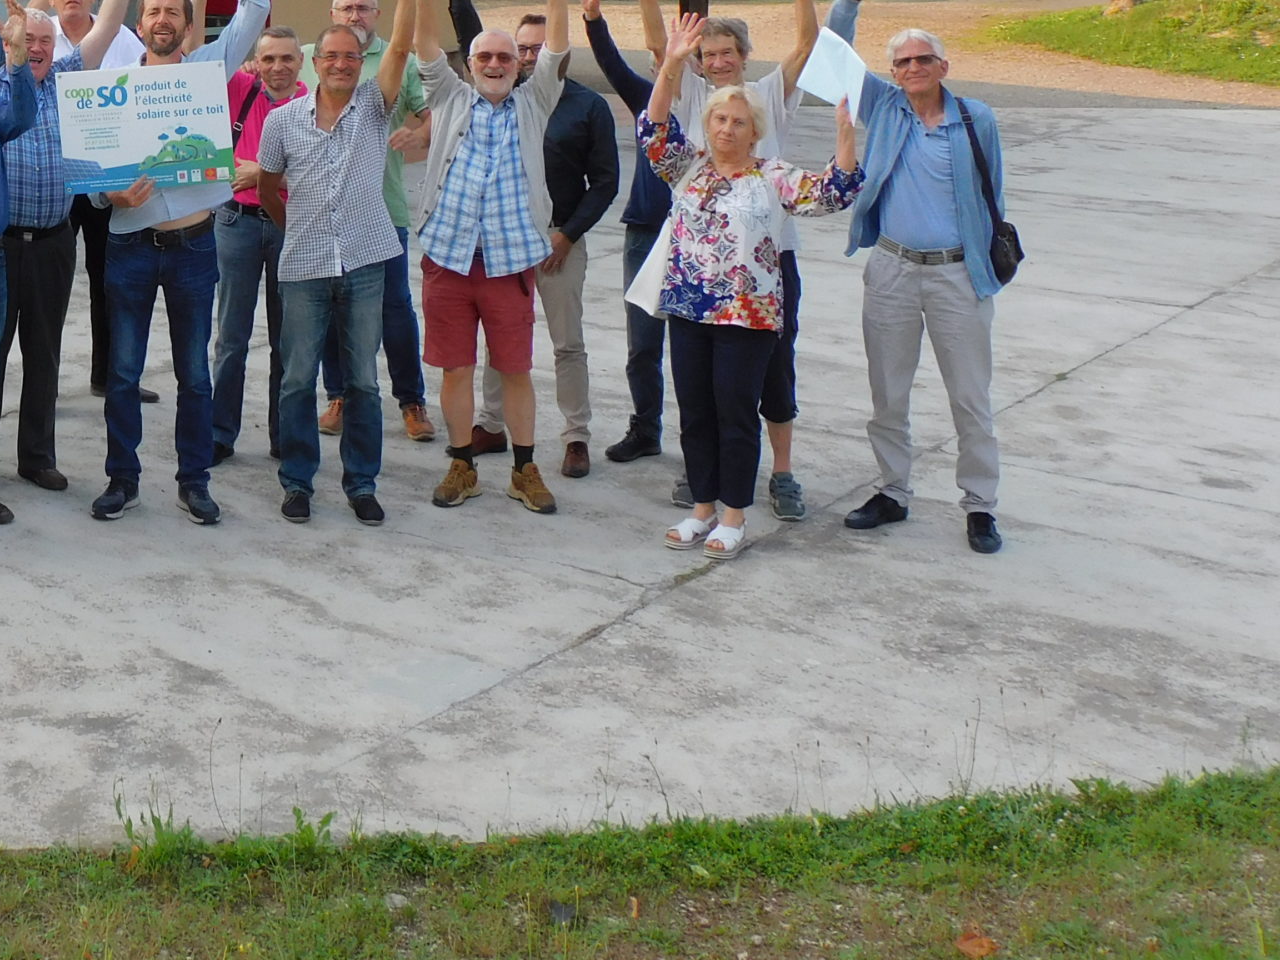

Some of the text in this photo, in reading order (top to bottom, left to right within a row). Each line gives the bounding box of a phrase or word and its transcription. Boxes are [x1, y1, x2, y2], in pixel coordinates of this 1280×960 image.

[65, 88, 95, 99] coop
[134, 79, 187, 94] produit de
[76, 85, 128, 110] de SO
[135, 93, 193, 106] l'électricité
[136, 103, 224, 120] solaire sur ce toit
